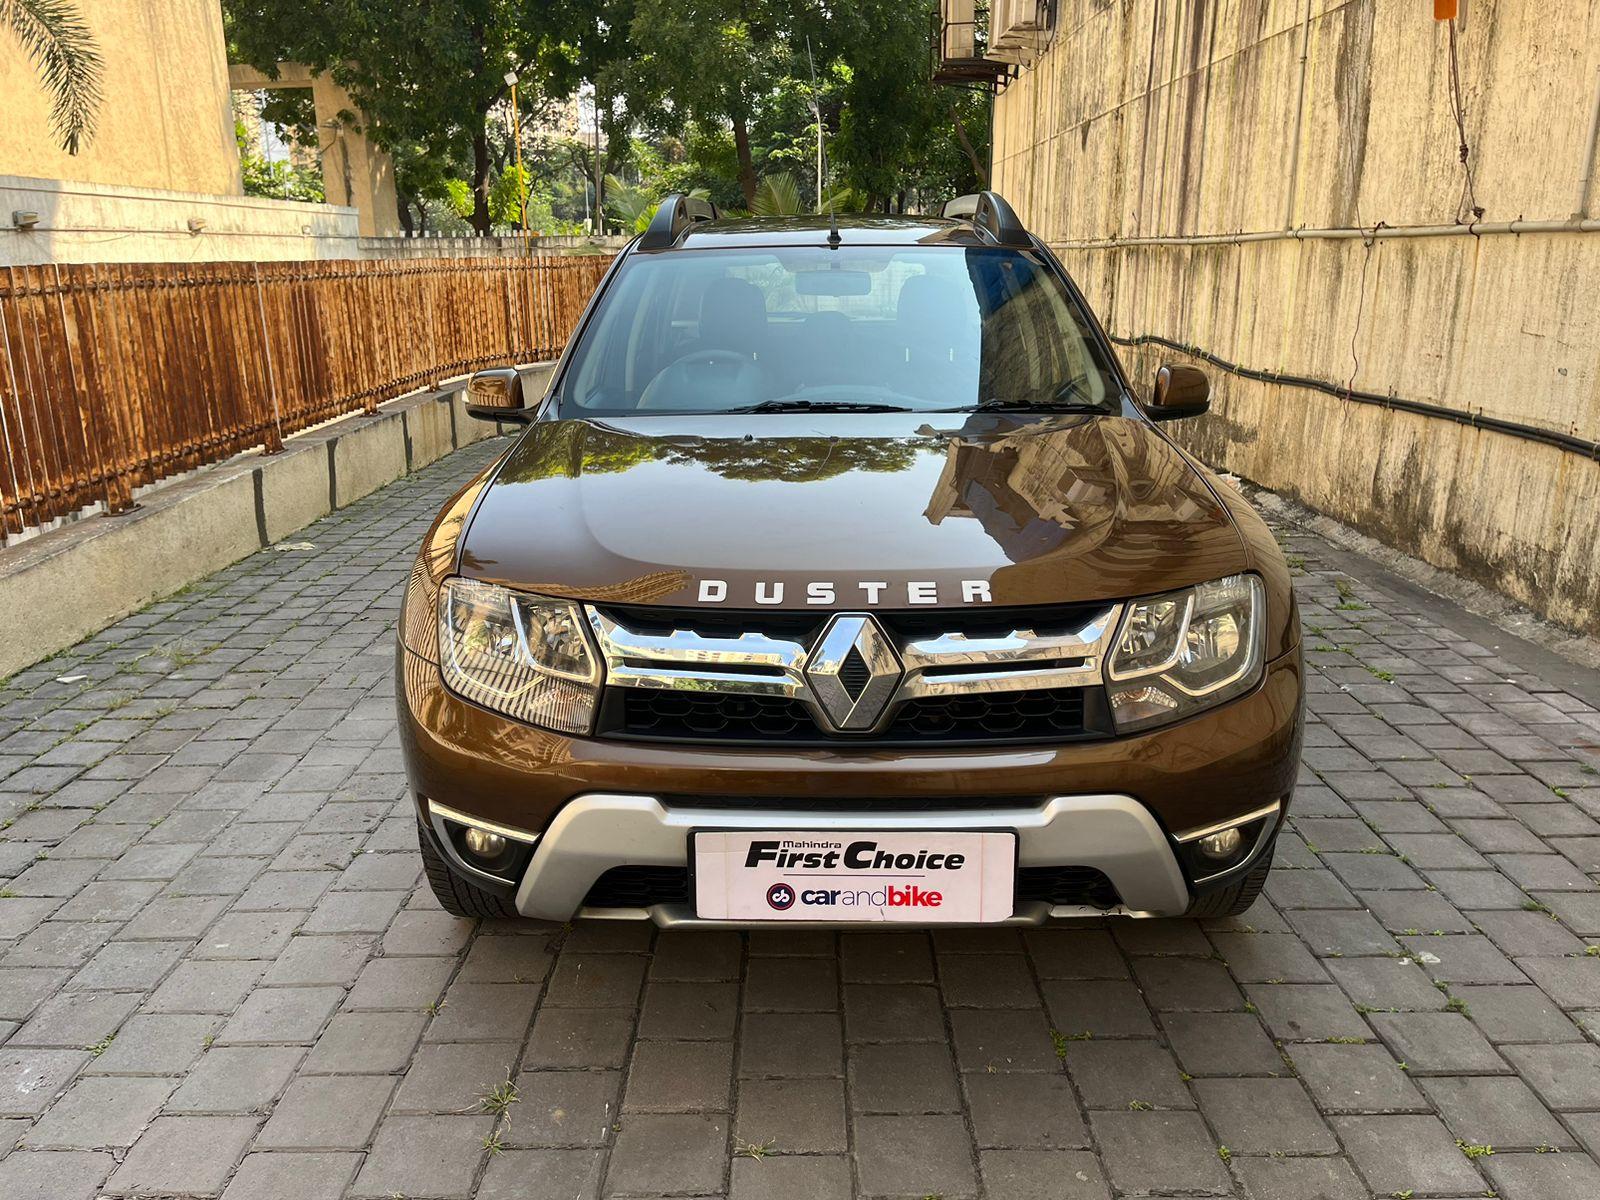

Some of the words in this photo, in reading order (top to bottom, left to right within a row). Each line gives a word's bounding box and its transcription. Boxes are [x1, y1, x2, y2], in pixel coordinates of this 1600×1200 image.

[698, 580, 993, 604] DUSTER
[745, 841, 840, 868] First
[843, 841, 965, 870] Choice
[782, 840, 842, 849] Mahindra
[801, 885, 943, 907] carandbike
